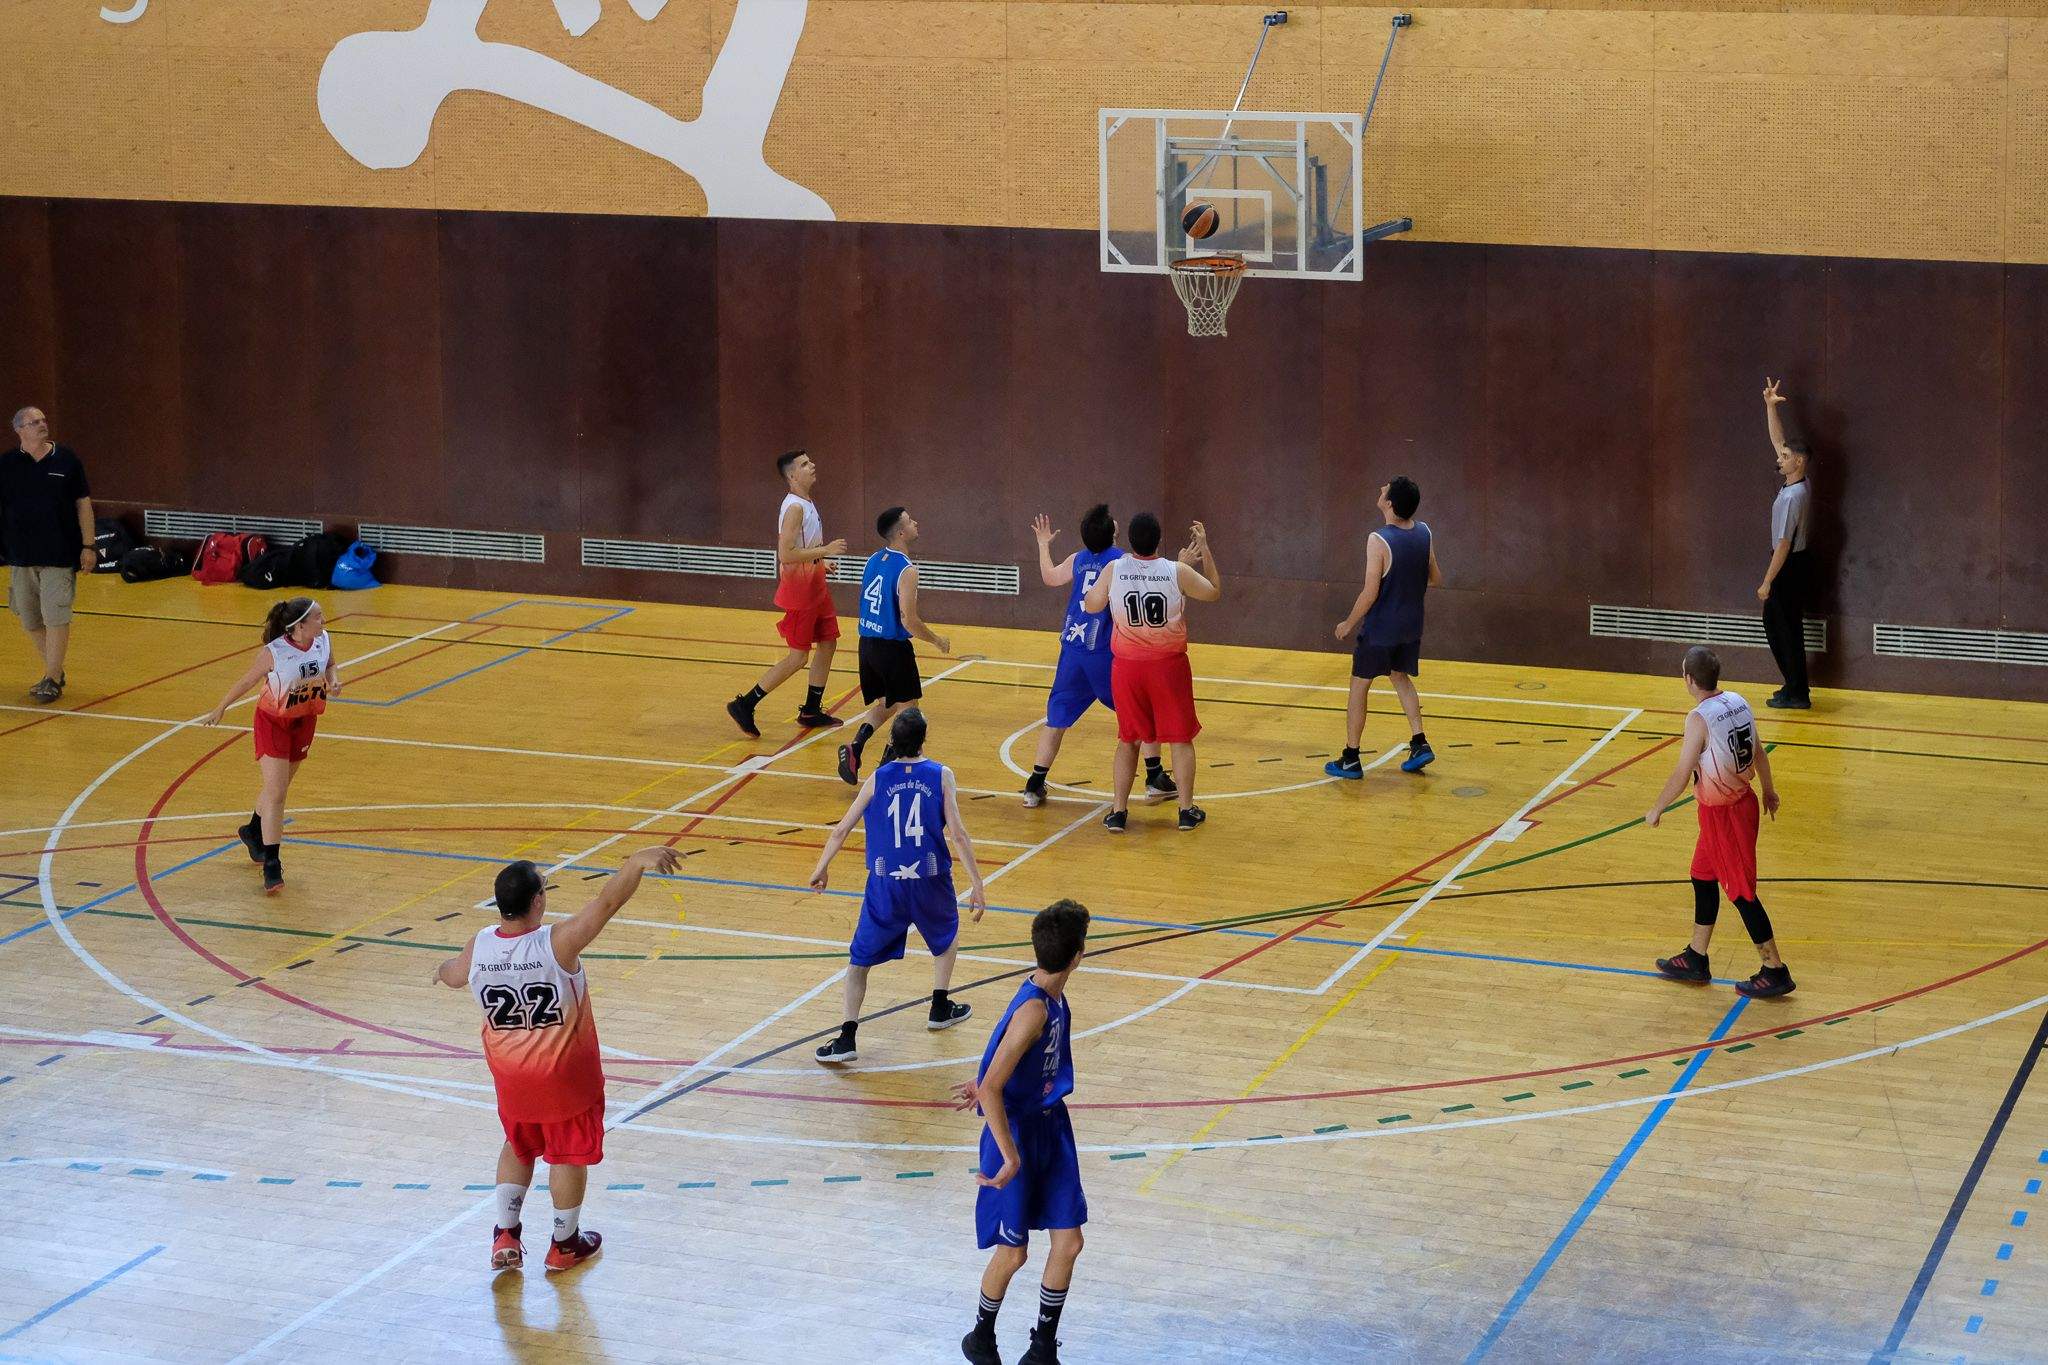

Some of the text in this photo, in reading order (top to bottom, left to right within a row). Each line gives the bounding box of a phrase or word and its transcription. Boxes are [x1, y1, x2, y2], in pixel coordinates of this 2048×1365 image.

[863, 574, 884, 616] 4
[1129, 574, 1147, 582] GRUP
[1123, 590, 1169, 628] 10
[298, 659, 321, 680] 15
[886, 792, 925, 849] 14
[487, 962, 512, 972] GRUP
[513, 960, 544, 971] BARNA
[480, 981, 565, 1031] 22
